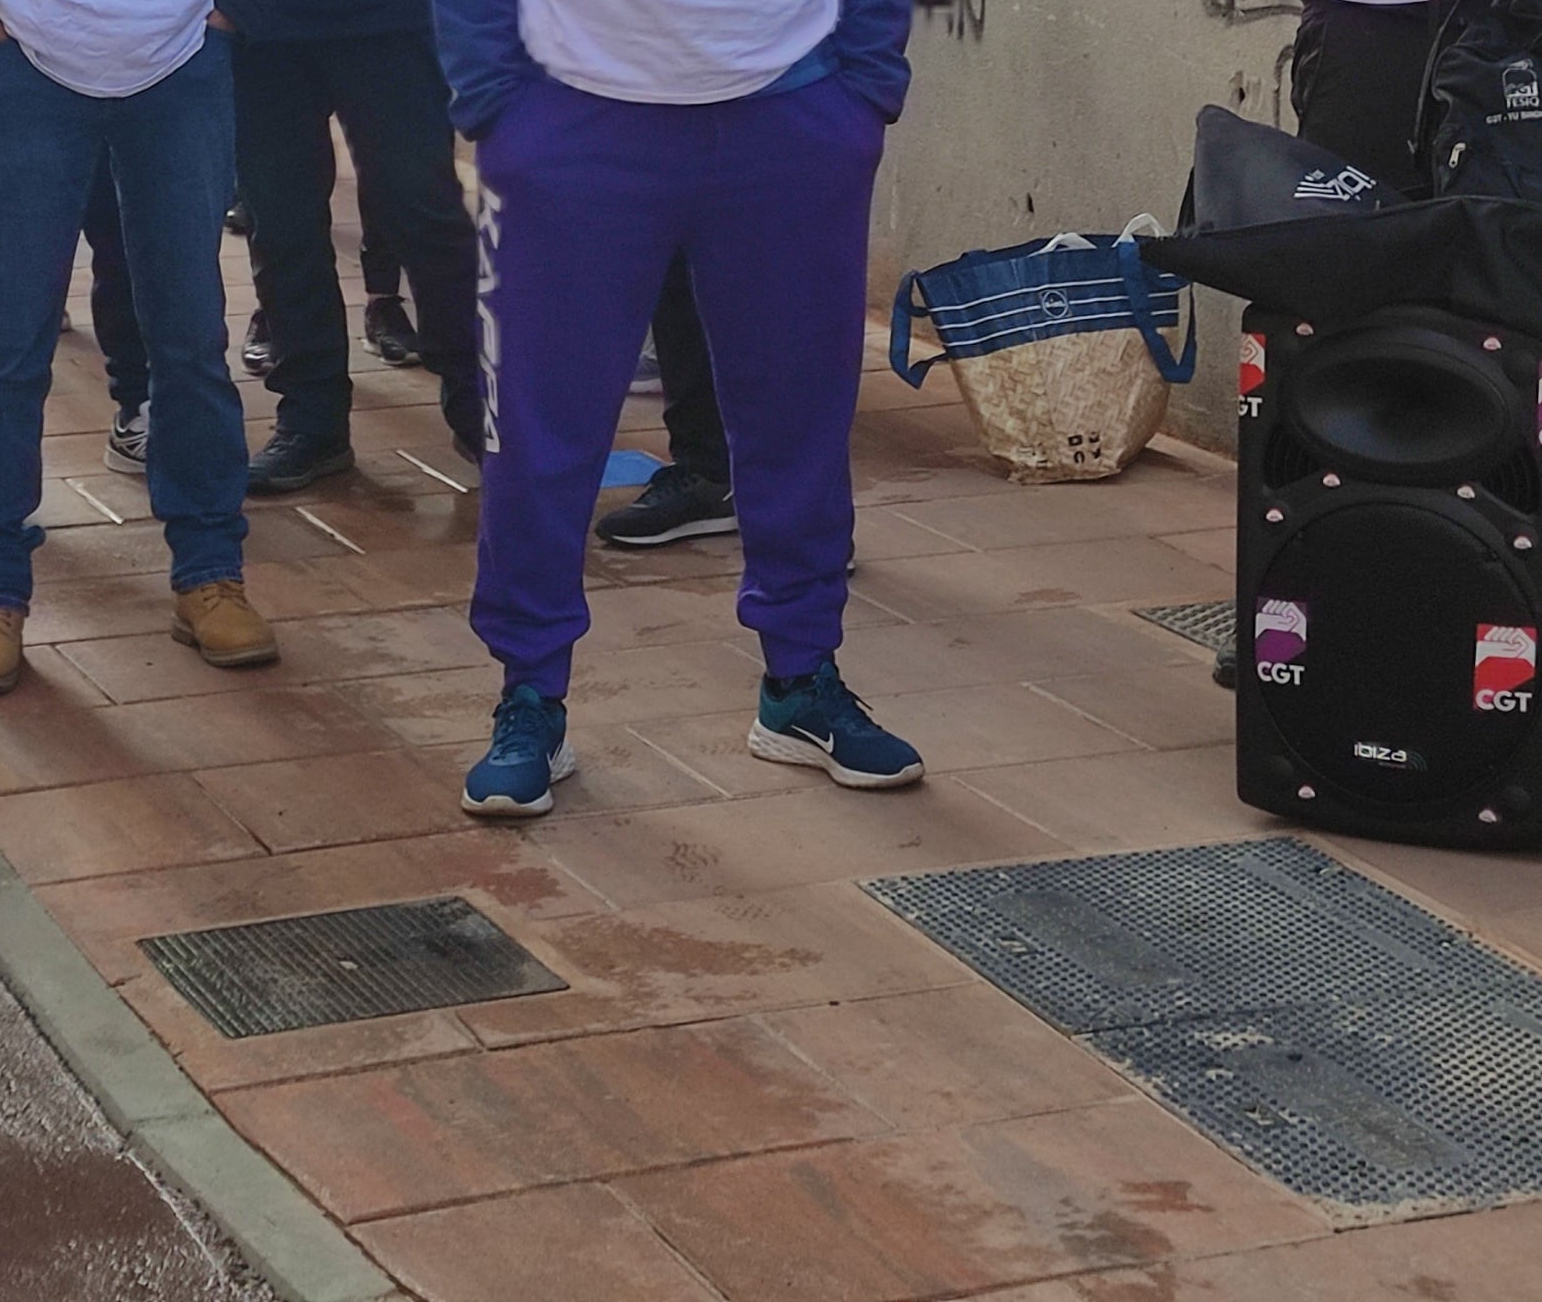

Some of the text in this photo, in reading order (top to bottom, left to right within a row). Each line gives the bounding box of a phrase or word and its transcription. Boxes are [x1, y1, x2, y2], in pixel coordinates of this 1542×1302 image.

[1238, 394, 1263, 418] GT
[1257, 661, 1305, 686] CGT
[1476, 689, 1533, 713] CGT
